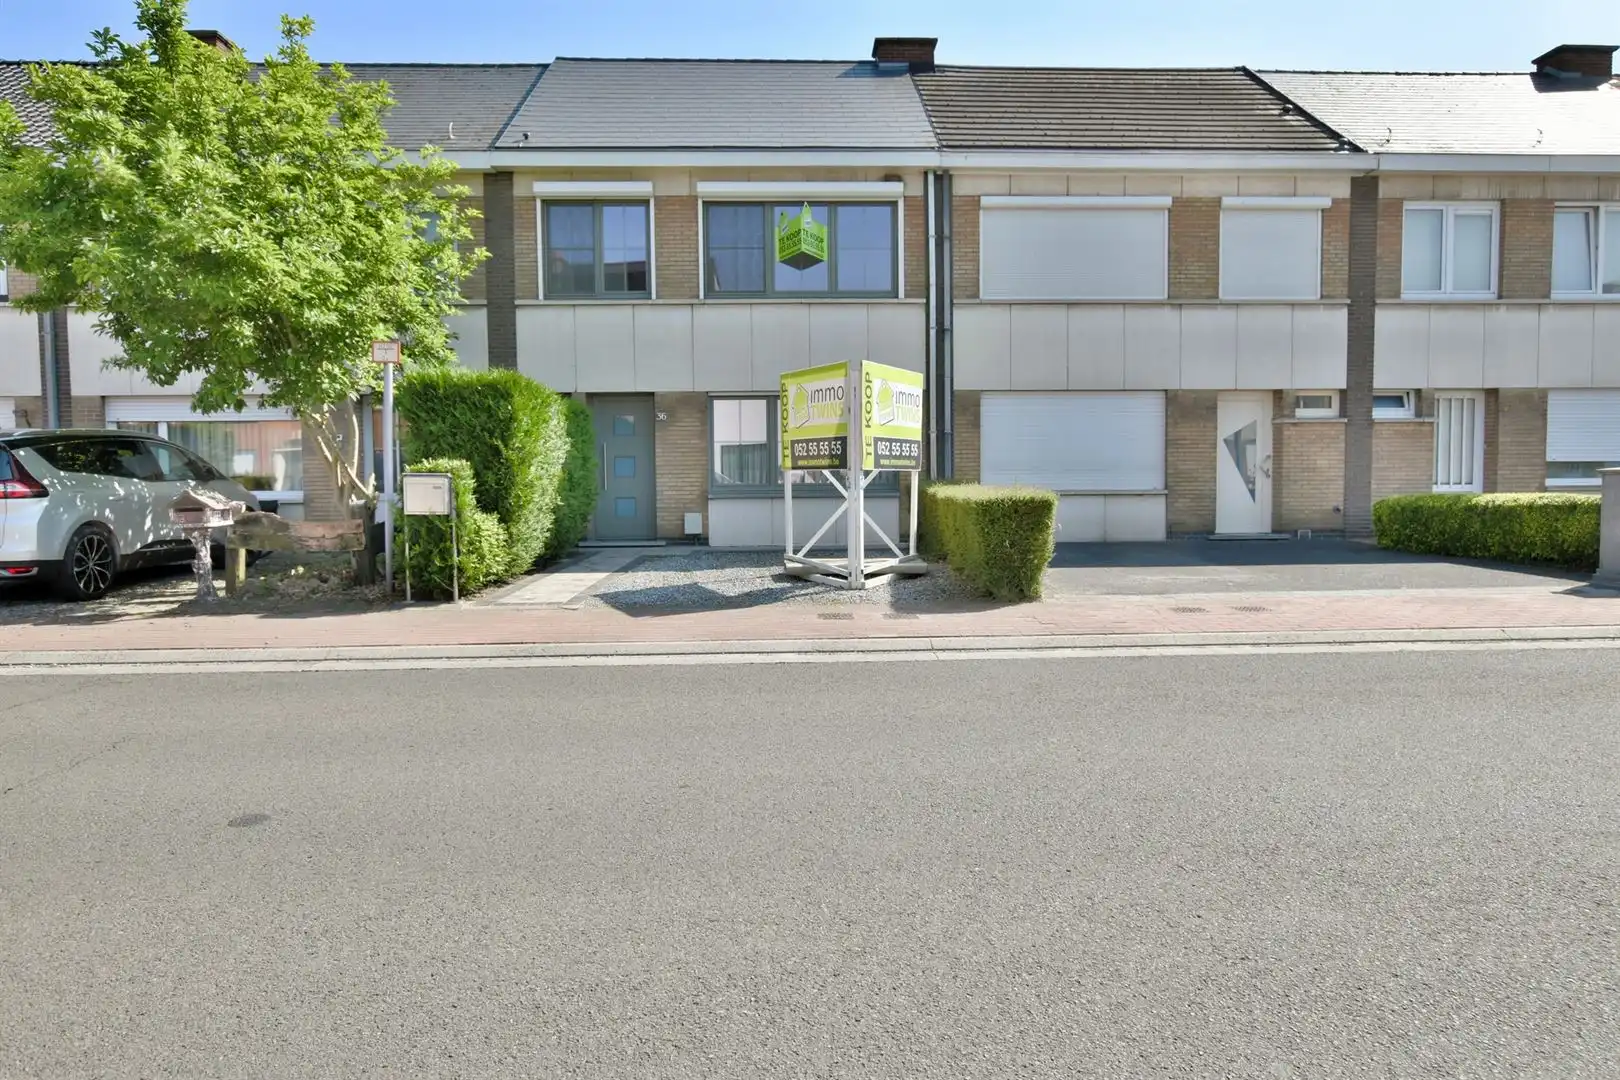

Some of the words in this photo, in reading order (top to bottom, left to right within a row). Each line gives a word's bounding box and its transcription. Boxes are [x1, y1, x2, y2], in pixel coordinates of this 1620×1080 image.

[811, 385, 844, 403] immo
[896, 388, 920, 408] immo
[656, 411, 667, 421] 36
[811, 402, 844, 419] TWINS
[896, 405, 920, 424] TWINS
[782, 440, 789, 459] TE
[794, 443, 807, 456] 052
[808, 442, 817, 456] 55
[820, 441, 829, 455] 55
[831, 440, 842, 454] 55
[865, 435, 872, 459] TE
[877, 441, 890, 456] 052
[891, 442, 901, 456] 55
[902, 442, 910, 456] 55
[911, 443, 919, 457] 55
